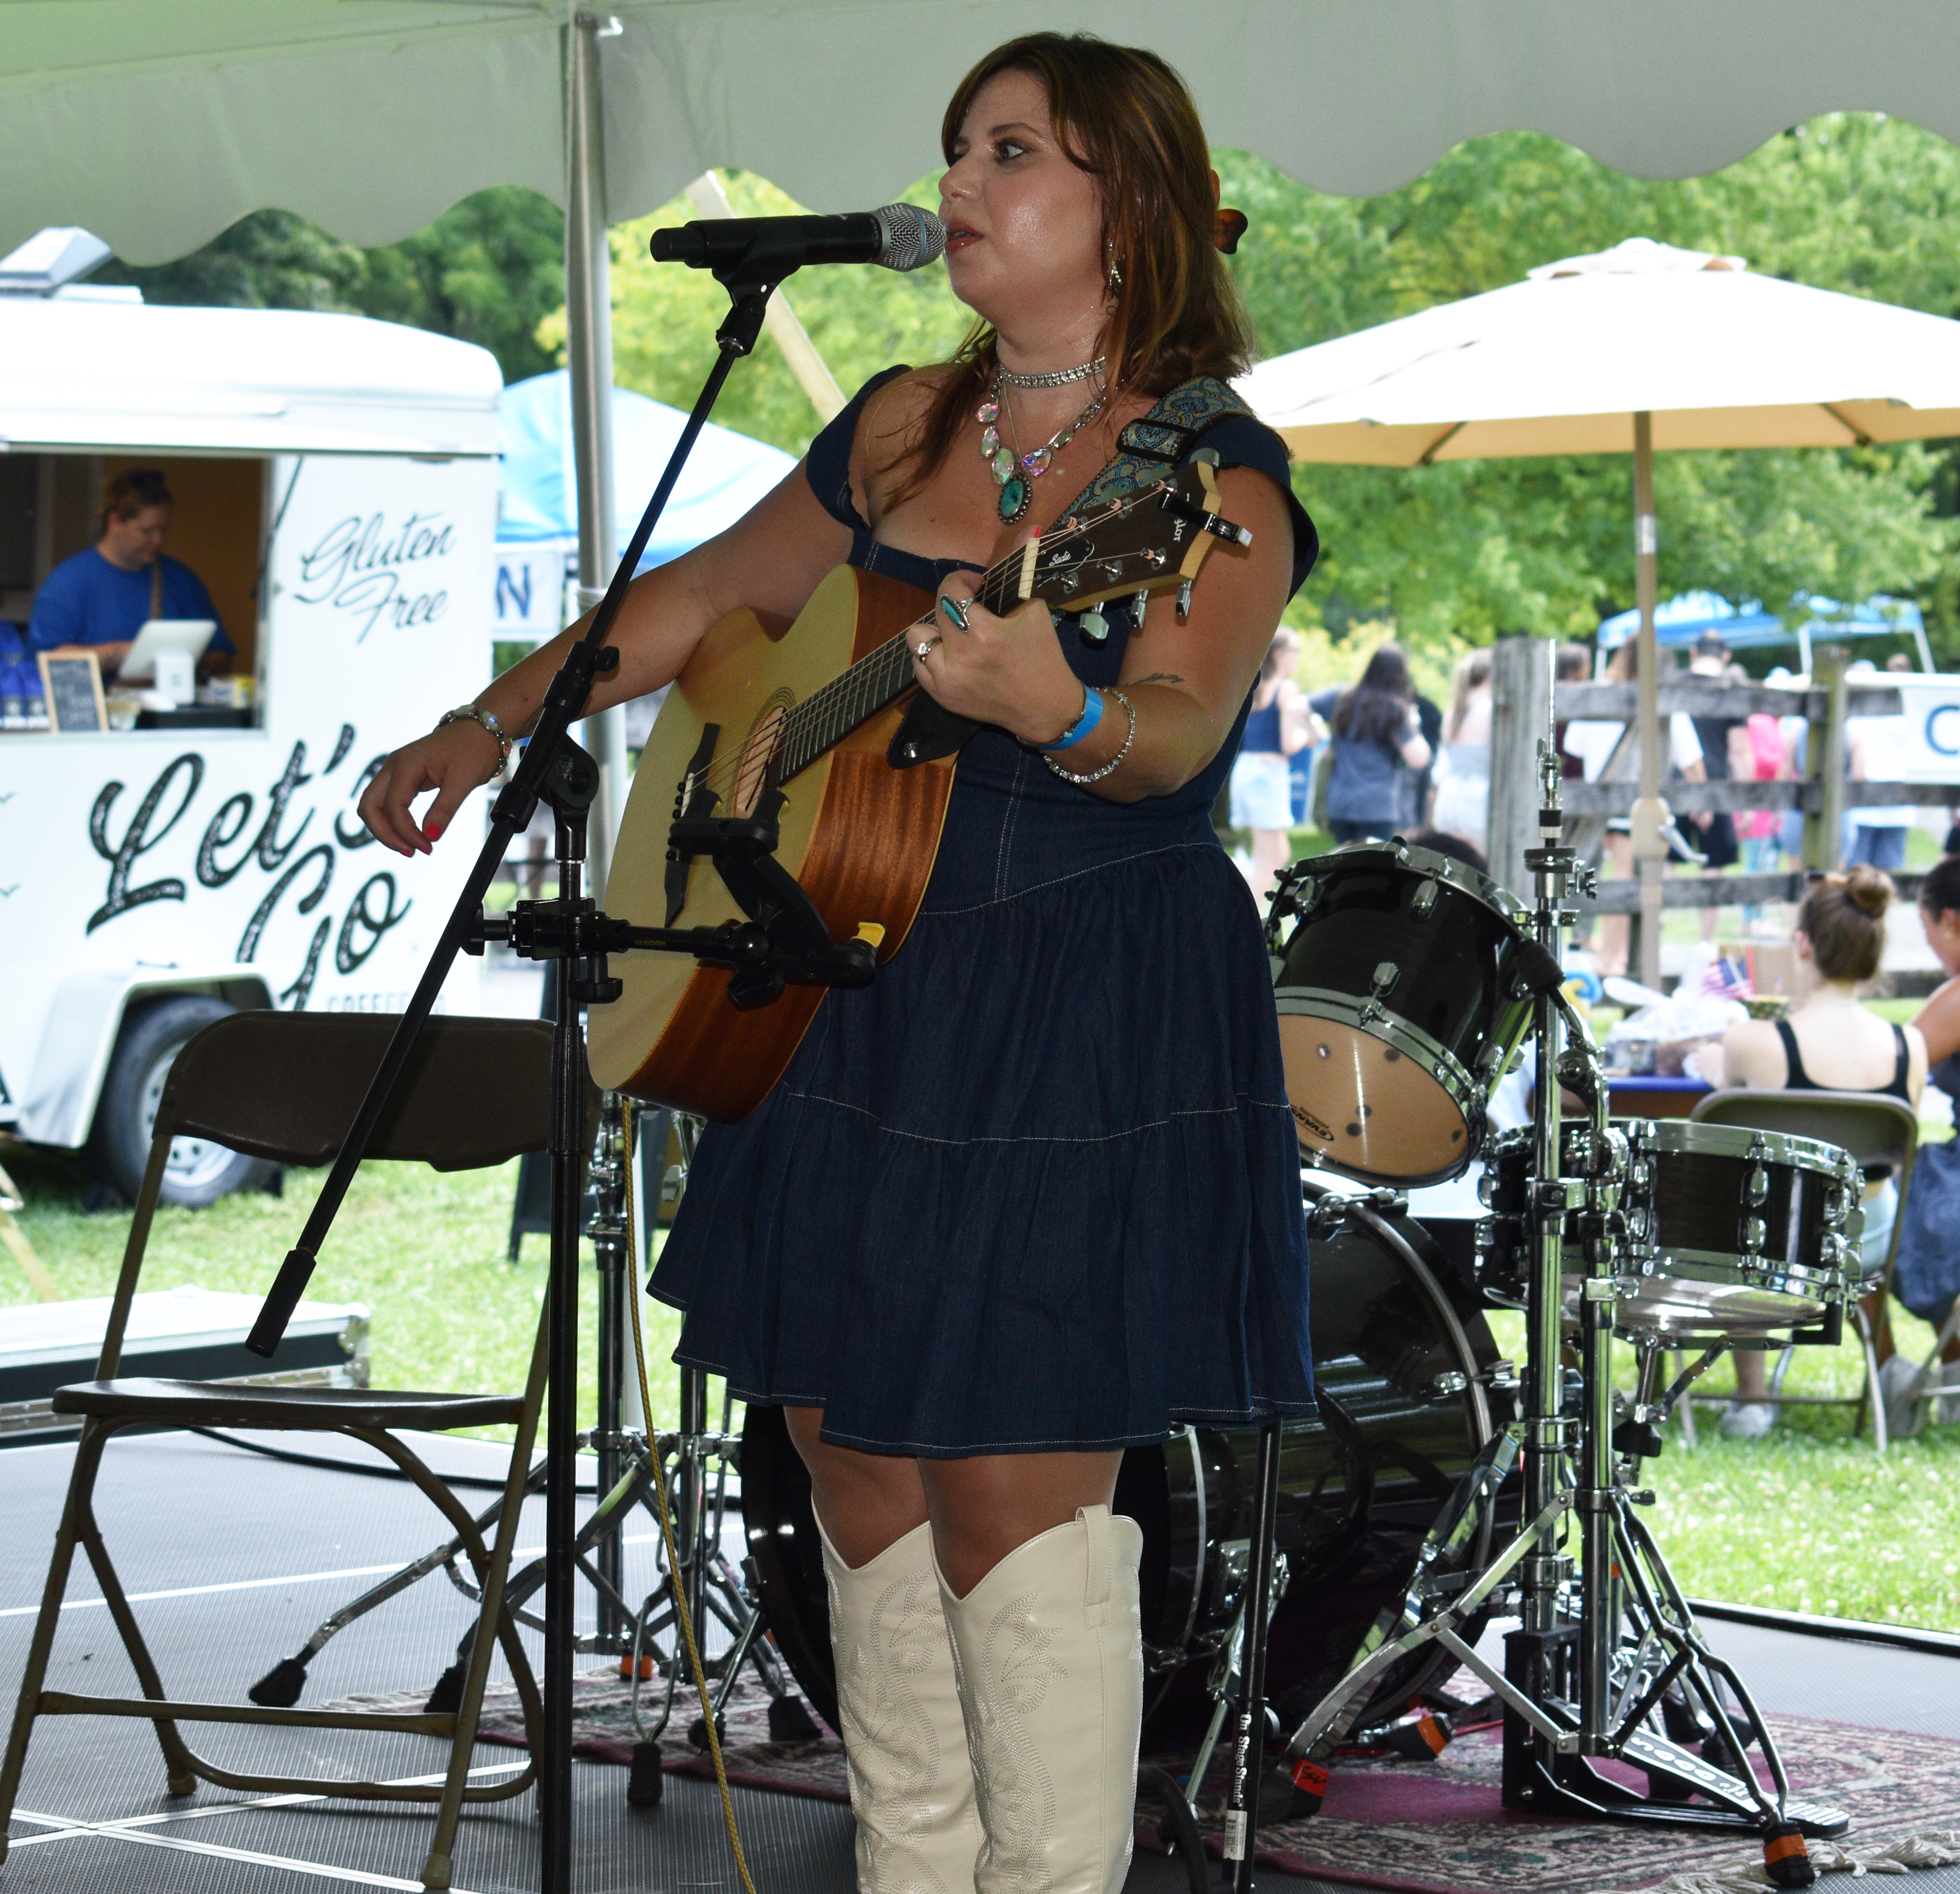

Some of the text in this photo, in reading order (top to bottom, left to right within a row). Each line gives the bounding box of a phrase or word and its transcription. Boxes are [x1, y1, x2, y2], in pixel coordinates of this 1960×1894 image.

[294, 511, 458, 604] Gluten
[1048, 550, 1071, 566] Sadie
[333, 571, 449, 645] Free
[236, 844, 413, 1011] Go
[1240, 1714, 1252, 1731] On
